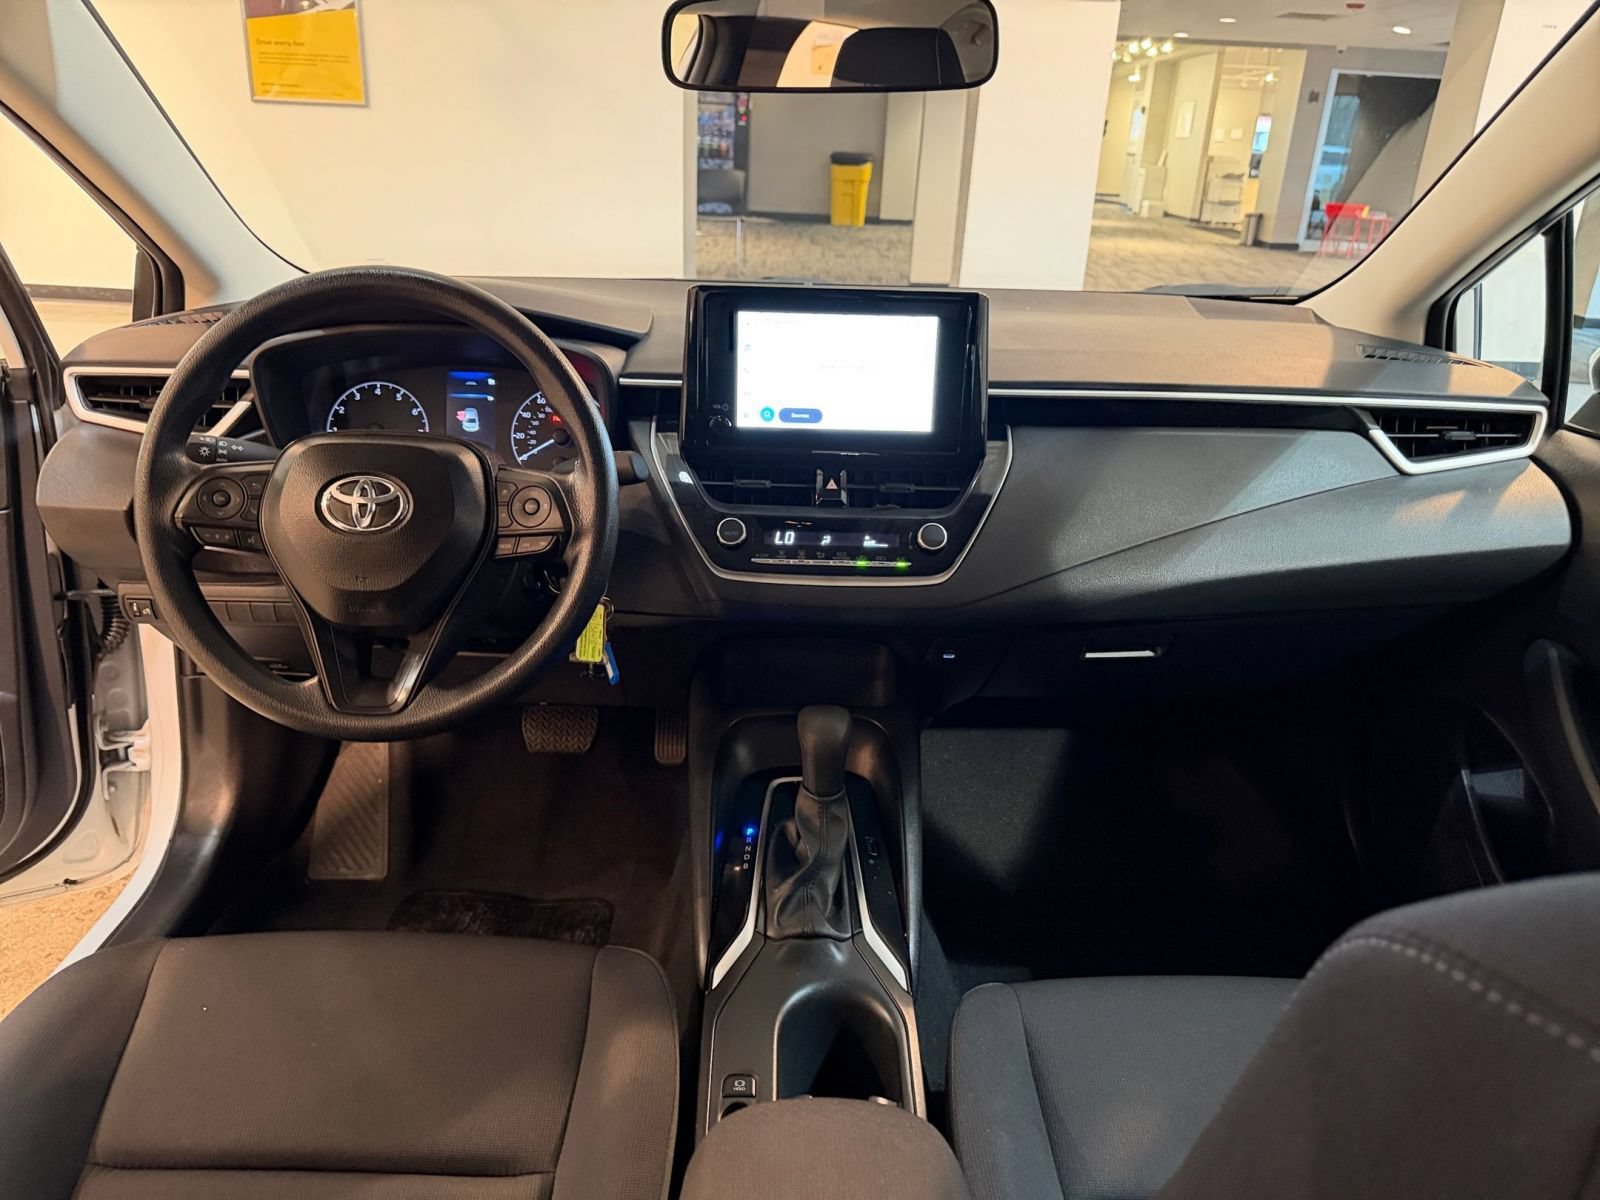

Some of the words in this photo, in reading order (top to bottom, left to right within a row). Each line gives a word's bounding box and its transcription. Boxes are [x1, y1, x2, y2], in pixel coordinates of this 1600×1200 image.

[374, 388, 381, 396] 4
[354, 393, 361, 401] 3
[396, 393, 402, 401] 5
[338, 406, 345, 414] 2
[411, 408, 418, 416] 6
